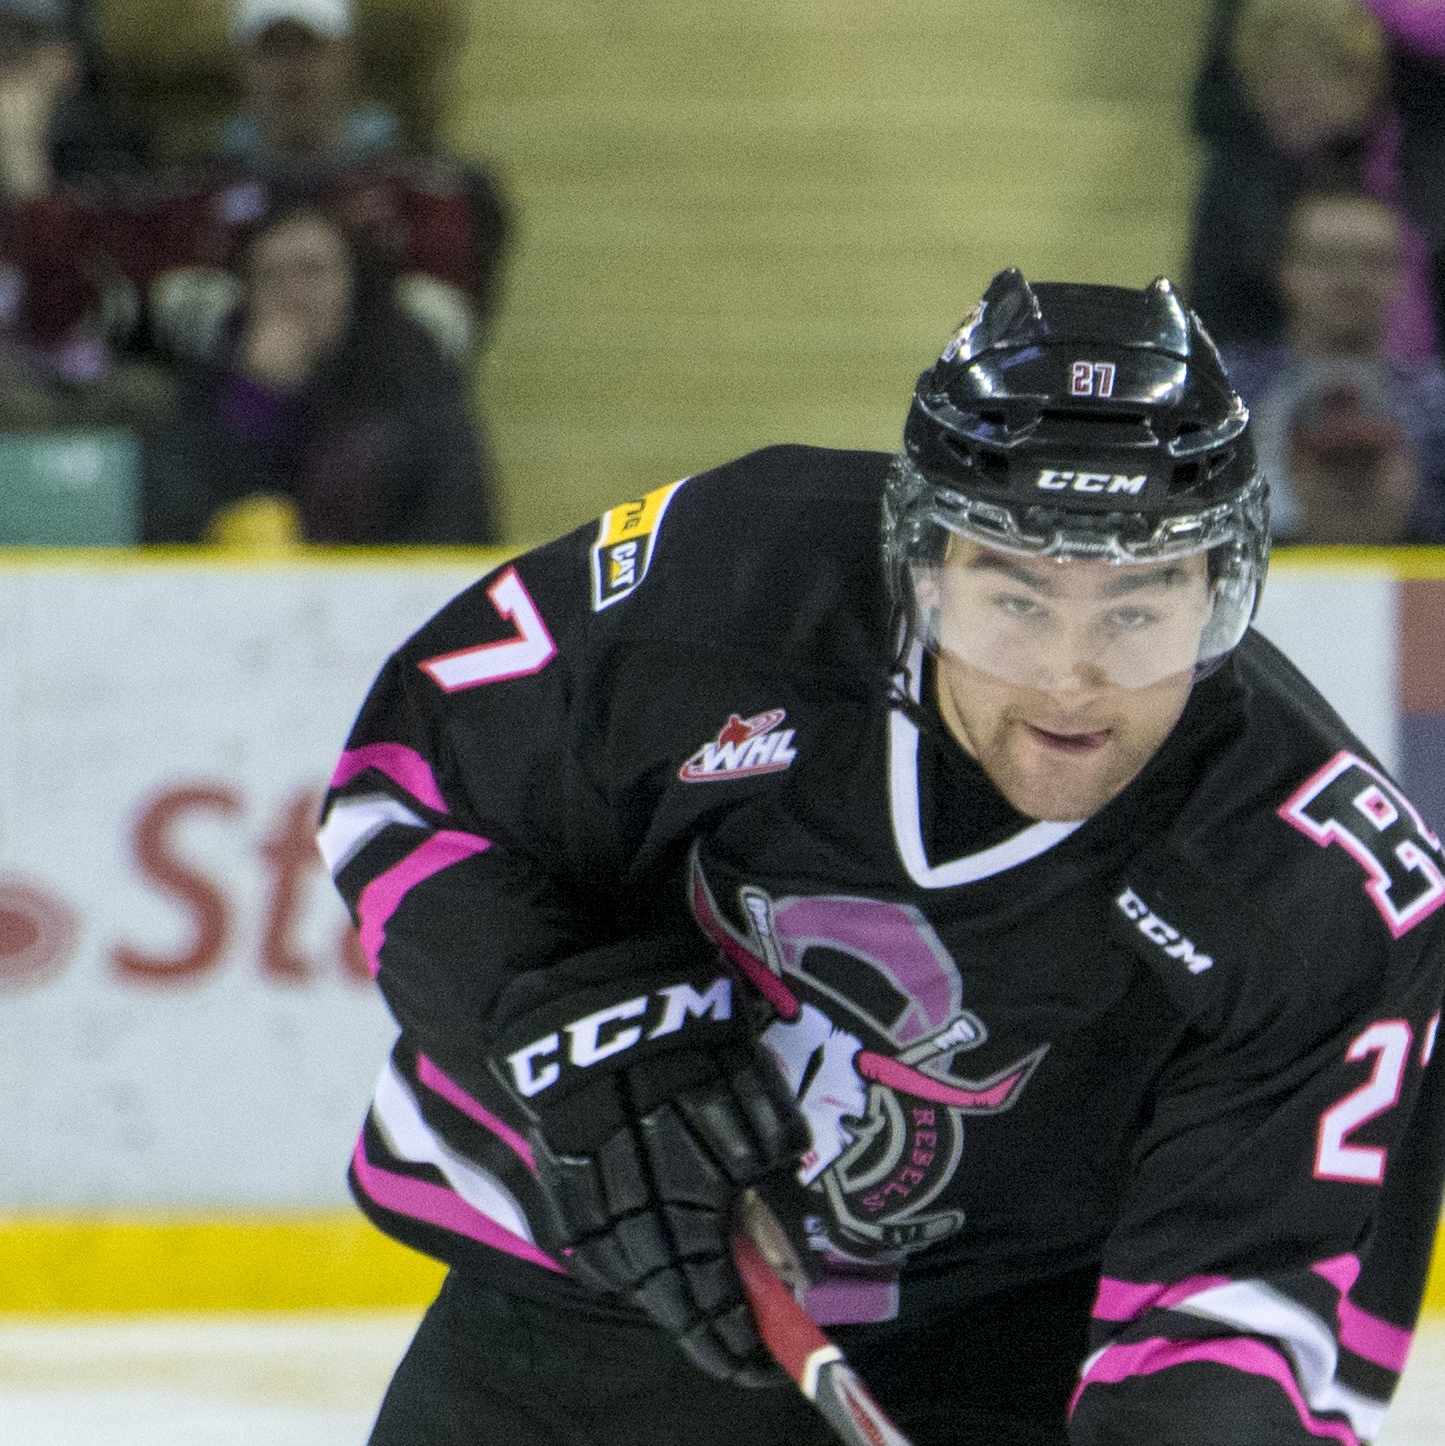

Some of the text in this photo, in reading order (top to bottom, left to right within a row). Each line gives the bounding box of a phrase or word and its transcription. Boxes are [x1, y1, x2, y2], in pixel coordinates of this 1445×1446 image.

[1072, 361, 1116, 397] 27
[1037, 469, 1147, 495] CCM
[610, 541, 638, 589] CAT
[417, 564, 558, 694] 7
[700, 728, 797, 773] WHL
[1117, 886, 1214, 975] CCM
[507, 976, 732, 1098] CCM
[861, 1107, 939, 1213] REBELS
